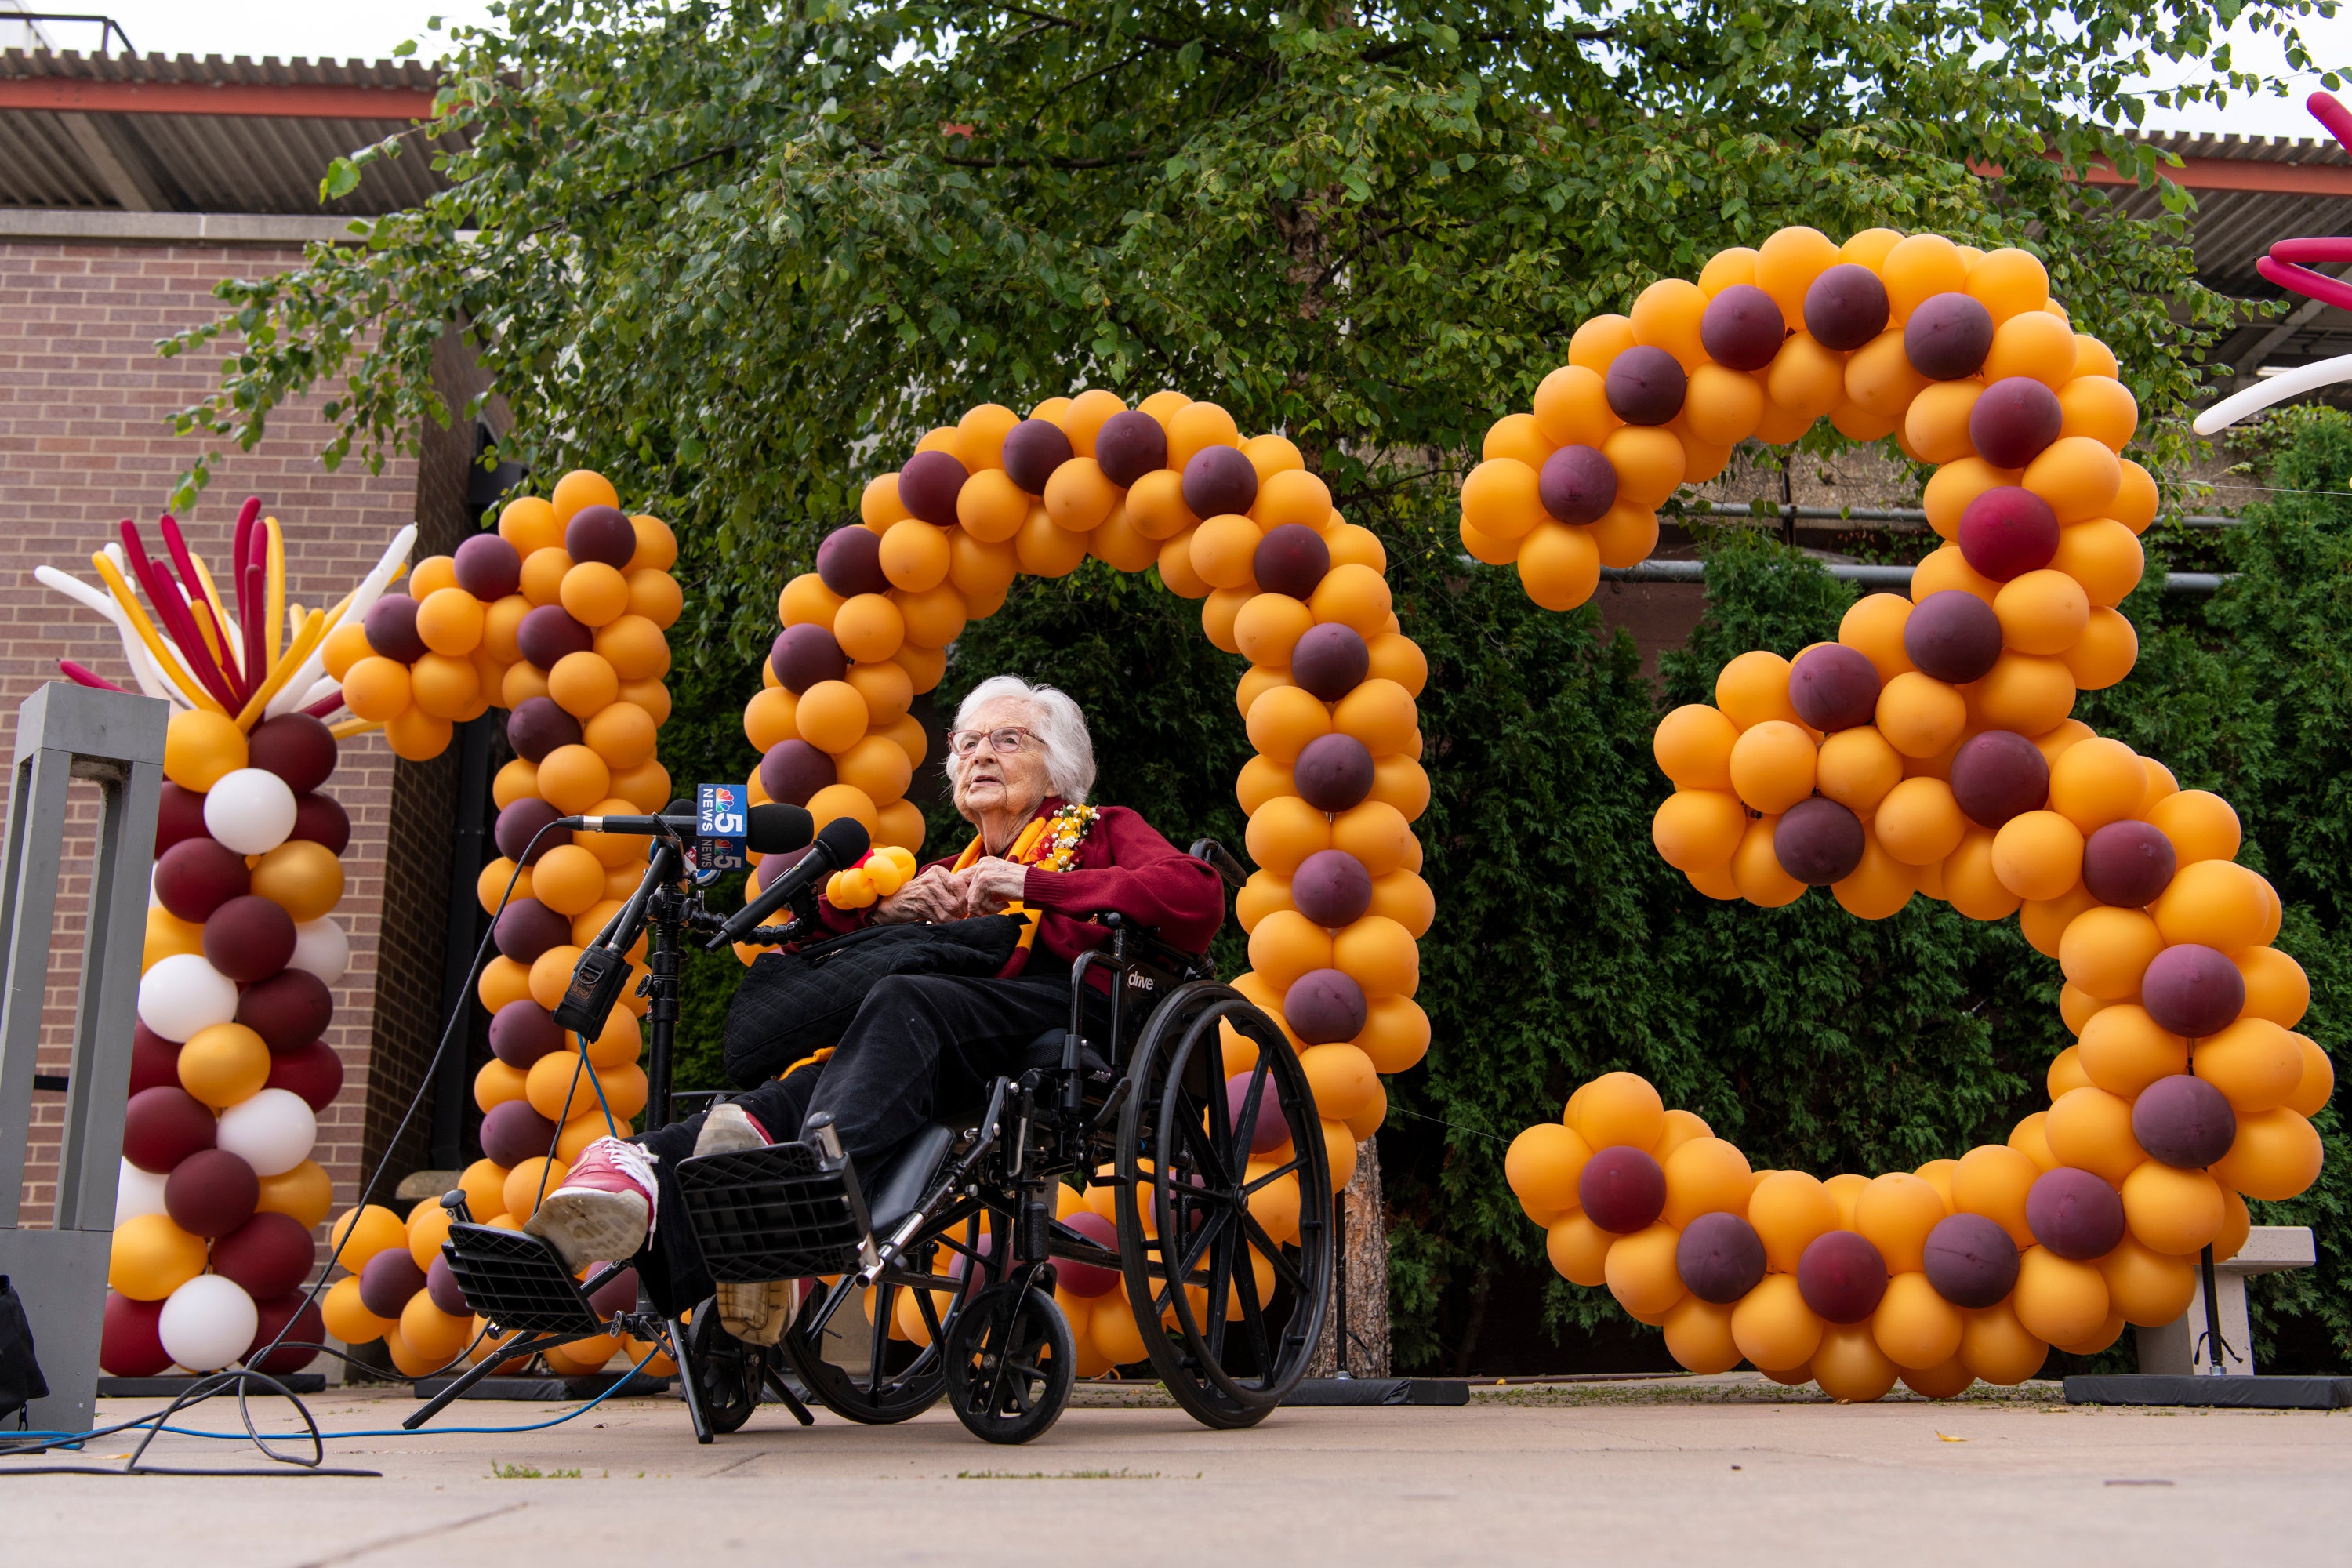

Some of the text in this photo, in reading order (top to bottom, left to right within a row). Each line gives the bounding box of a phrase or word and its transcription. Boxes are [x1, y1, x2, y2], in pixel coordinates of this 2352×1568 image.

[702, 788, 713, 832] NEWS
[714, 812, 743, 833] 5
[701, 839, 712, 868] NEWS
[713, 855, 742, 869] 5
[1128, 971, 1154, 991] drive
